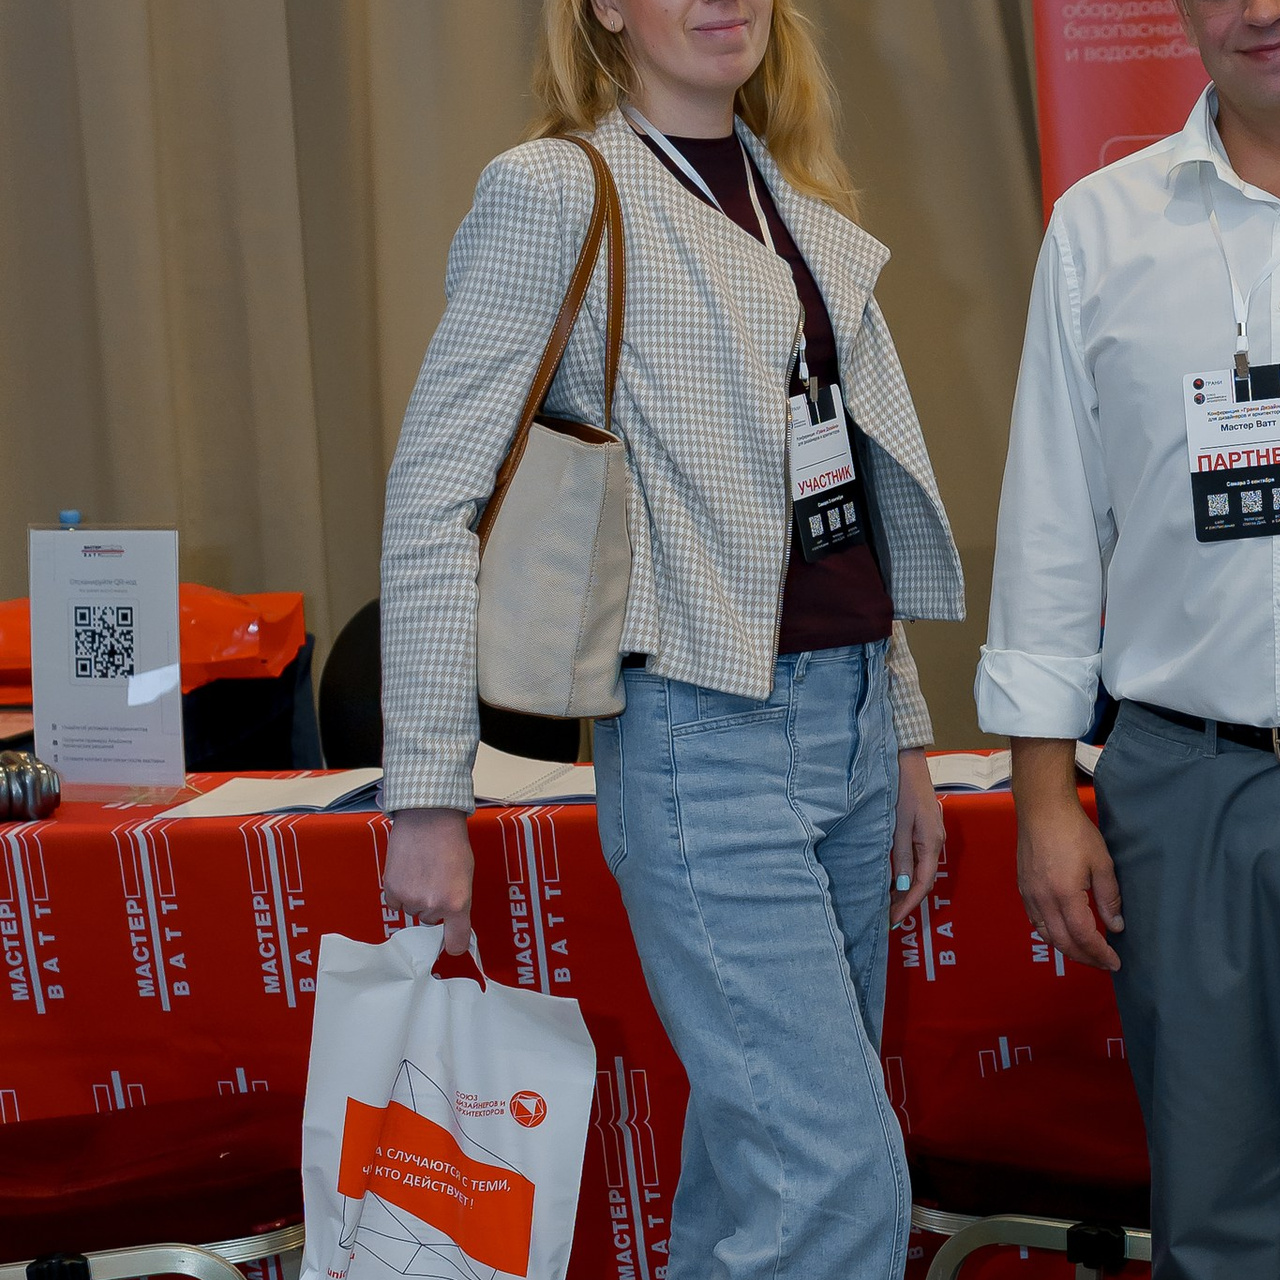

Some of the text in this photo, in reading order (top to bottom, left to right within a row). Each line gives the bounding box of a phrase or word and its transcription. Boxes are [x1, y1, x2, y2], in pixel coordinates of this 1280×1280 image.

[1220, 420, 1277, 432] Мастер Ватт
[798, 465, 852, 495] УЧАСТНИК
[0, 903, 29, 1001] МАСТЕР
[34, 904, 65, 999] ВАТТ
[126, 899, 155, 997] МАСТЕР
[161, 900, 190, 996] ВАТТ
[253, 895, 281, 994] МАСТЕР
[288, 895, 316, 992] ВАТТ
[508, 885, 535, 985] МАСТЕР
[545, 886, 571, 983] ВАТТ
[456, 1091, 478, 1101] СОЮЗ
[375, 1165, 401, 1180] КТО
[386, 1148, 461, 1181] СЛУЧАЮТСЯ
[462, 1177, 468, 1187] С
[471, 1179, 511, 1192] ТЕМИ,
[644, 1189, 668, 1280] ВАТТ
